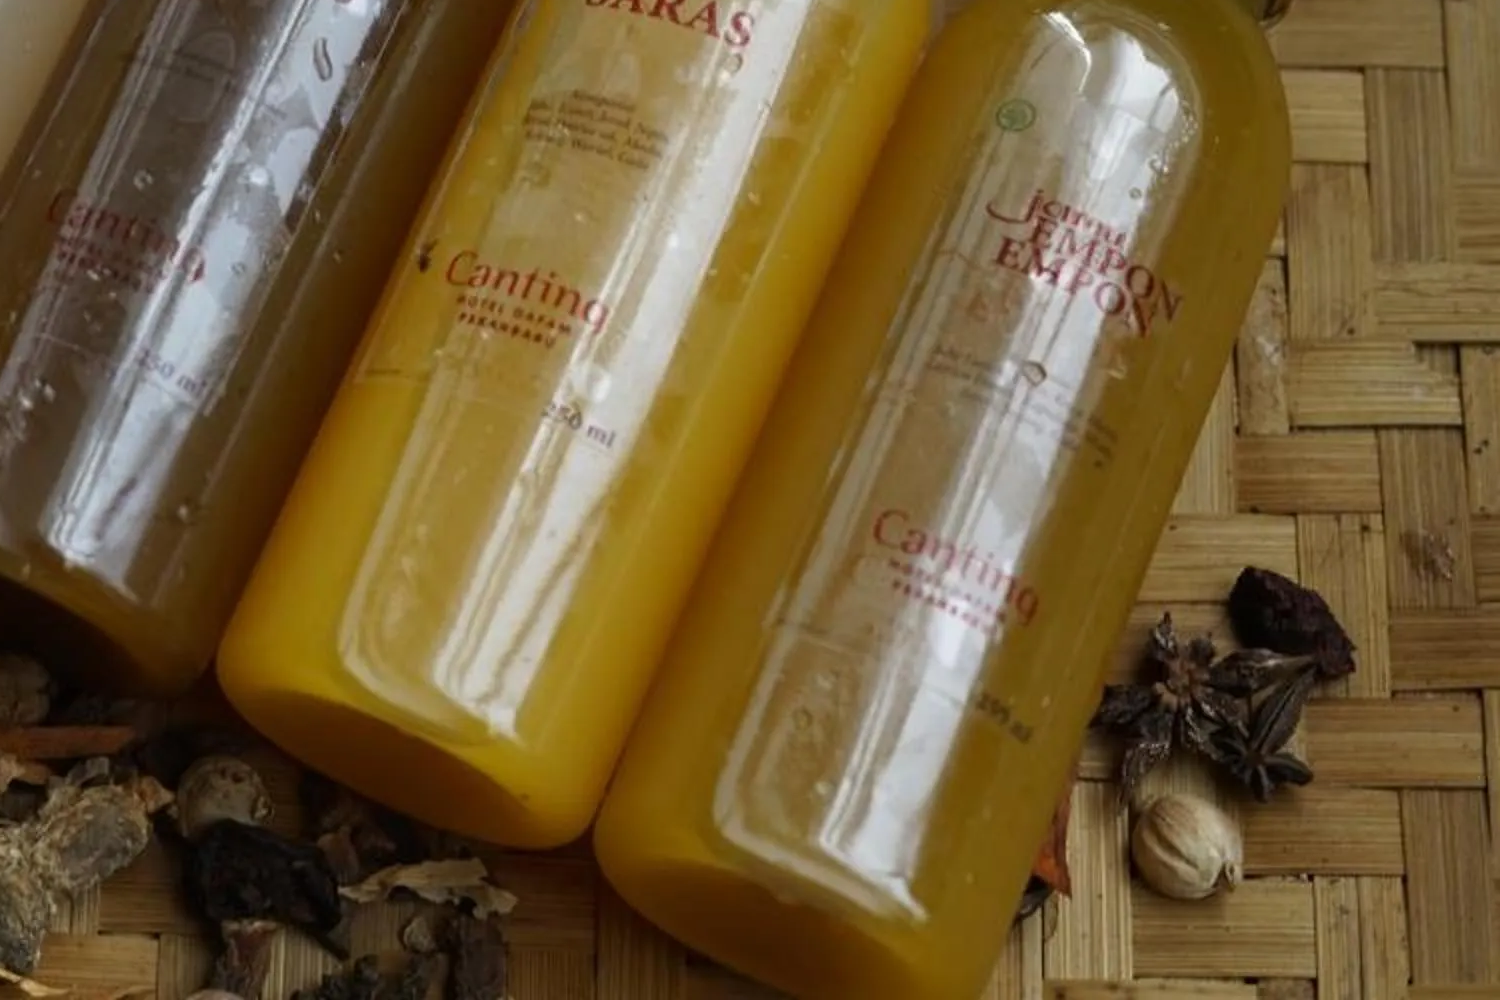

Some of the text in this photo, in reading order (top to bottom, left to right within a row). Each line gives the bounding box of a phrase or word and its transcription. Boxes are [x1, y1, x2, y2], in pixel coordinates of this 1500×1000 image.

[47, 188, 206, 284] Canting
[445, 249, 609, 337] Canting
[541, 401, 616, 448] 250 ml
[873, 508, 1039, 626] Canting
